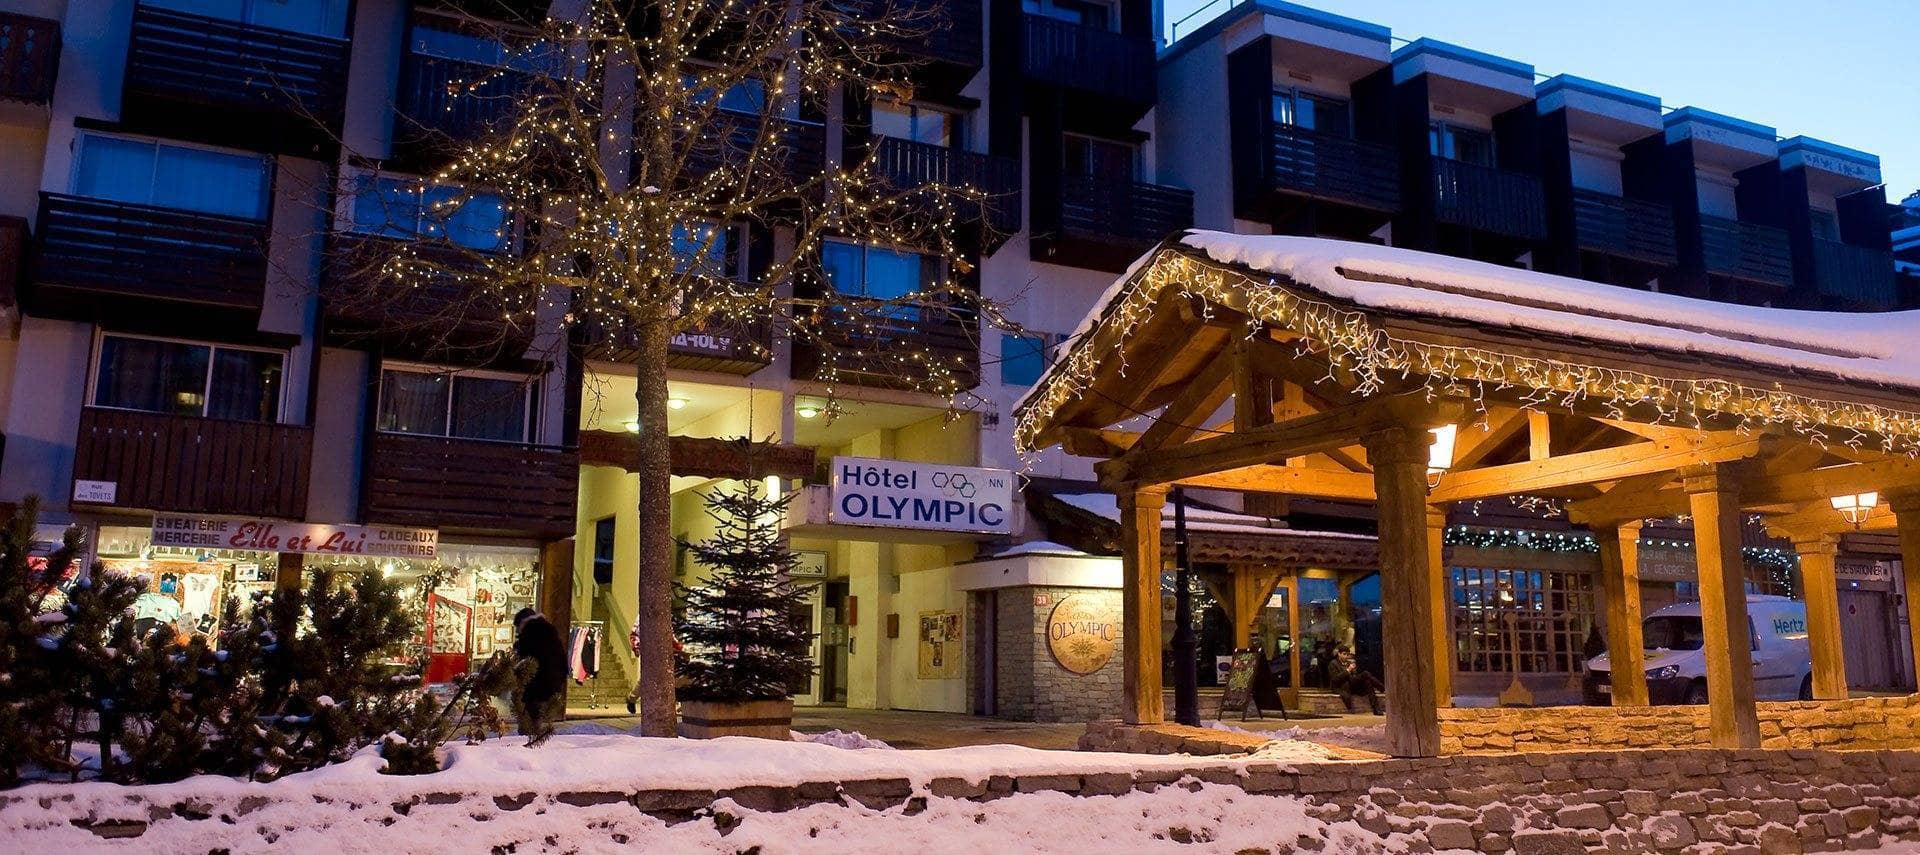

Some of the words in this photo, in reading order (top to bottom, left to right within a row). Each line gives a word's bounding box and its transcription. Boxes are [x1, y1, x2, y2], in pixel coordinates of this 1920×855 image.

[842, 464, 917, 490] Hôtel
[988, 478, 1004, 489] NN
[841, 493, 1004, 527] OLYMPIC
[156, 518, 228, 532] SWEATERIE
[154, 531, 220, 545] MERCERIE
[229, 521, 280, 549] Elle
[286, 535, 312, 551] et
[317, 531, 367, 553] Lui
[379, 529, 434, 543] CADEAUX
[367, 542, 434, 556] SOUVENIRS
[1051, 621, 1113, 642] OLYMPIC
[1773, 617, 1806, 634] Hertz
